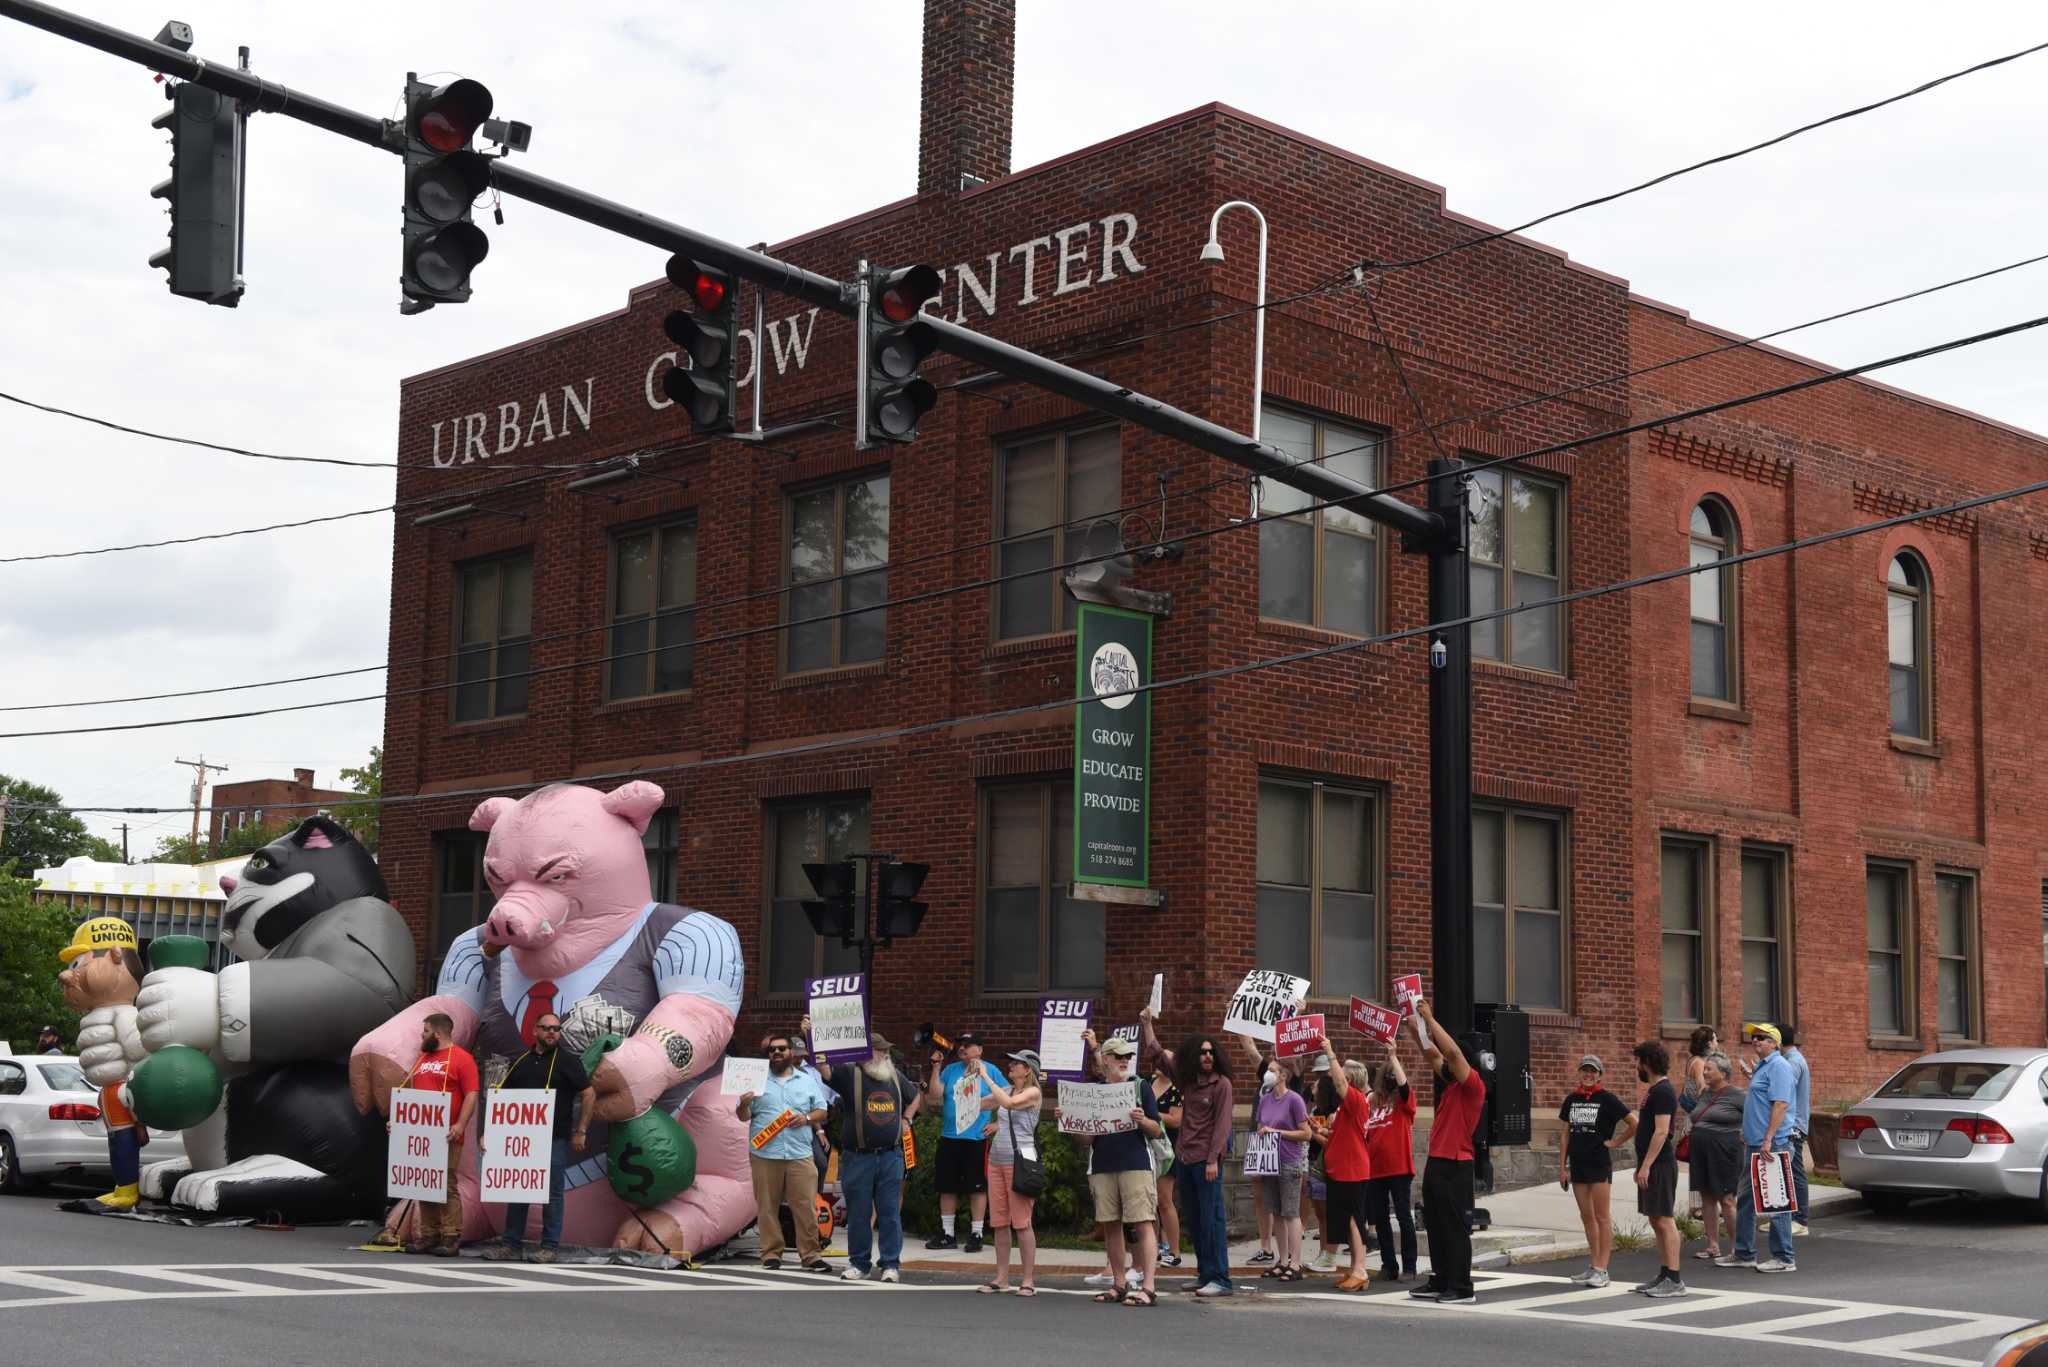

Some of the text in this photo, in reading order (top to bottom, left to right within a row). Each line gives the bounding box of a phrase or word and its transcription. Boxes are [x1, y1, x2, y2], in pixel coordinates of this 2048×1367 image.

[431, 377, 594, 468] URBAN
[919, 212, 1147, 324] ENTER
[1092, 728, 1134, 747] GROW
[1082, 759, 1143, 781] EDUCATE
[1083, 792, 1140, 812] PROVIDE
[91, 923, 133, 933] LOCAL
[92, 932, 133, 943] UNION
[810, 976, 860, 997] SEIU
[1245, 981, 1279, 997] SEEDS
[1273, 972, 1296, 990] THE
[1043, 1000, 1088, 1017] SEIU
[1227, 994, 1296, 1026] FAIR LABOR
[1377, 1011, 1386, 1022] IN
[1285, 1019, 1310, 1032] UUP IN
[1354, 1009, 1392, 1033] SOLIDARITY
[1113, 1025, 1139, 1041] SEIU
[1279, 1028, 1319, 1044] SOLIDARITY
[395, 1102, 445, 1127] HONK
[491, 1102, 549, 1126] HONK
[407, 1135, 430, 1157] FOR
[505, 1136, 531, 1157] FOR
[1245, 1152, 1277, 1172] FOR ALL
[391, 1165, 444, 1190] SUPPORT
[486, 1167, 546, 1190] SUPPORT
